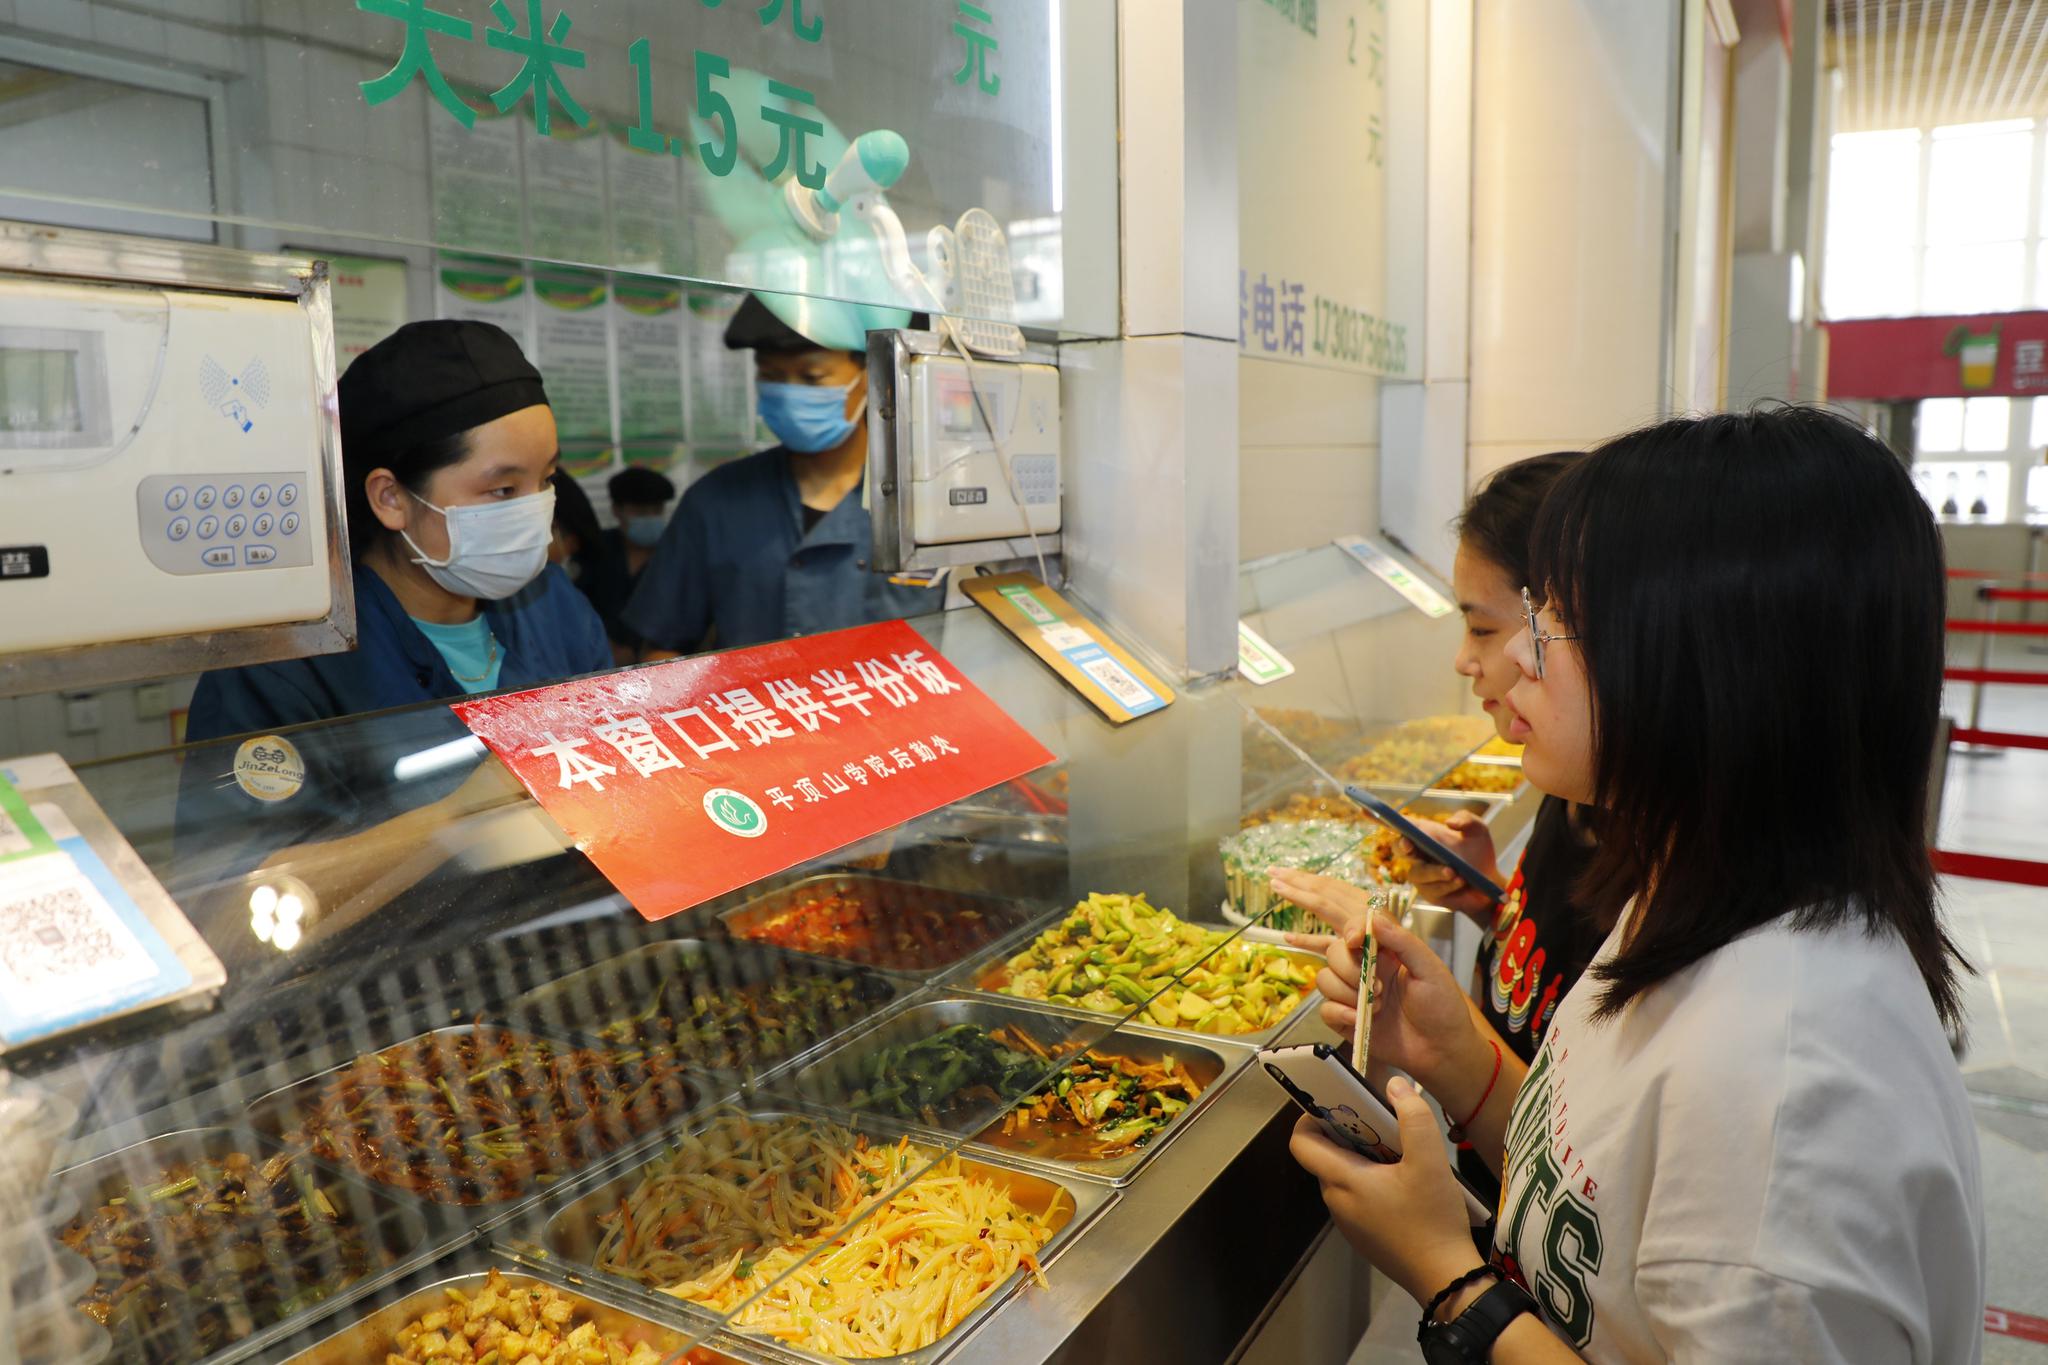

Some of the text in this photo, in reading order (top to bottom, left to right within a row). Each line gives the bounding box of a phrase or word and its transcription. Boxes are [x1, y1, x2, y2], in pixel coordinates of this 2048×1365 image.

[356, 0, 591, 136] 大米
[953, 0, 1000, 96] 元
[175, 519, 293, 535] 6 7 8 9 0
[202, 493, 210, 503] 2
[231, 492, 239, 502] 3
[258, 491, 266, 501] 4
[285, 490, 292, 500] 5
[531, 649, 961, 792] 本窗口提供半份饭
[765, 734, 960, 811] 平顶山学院后勤处
